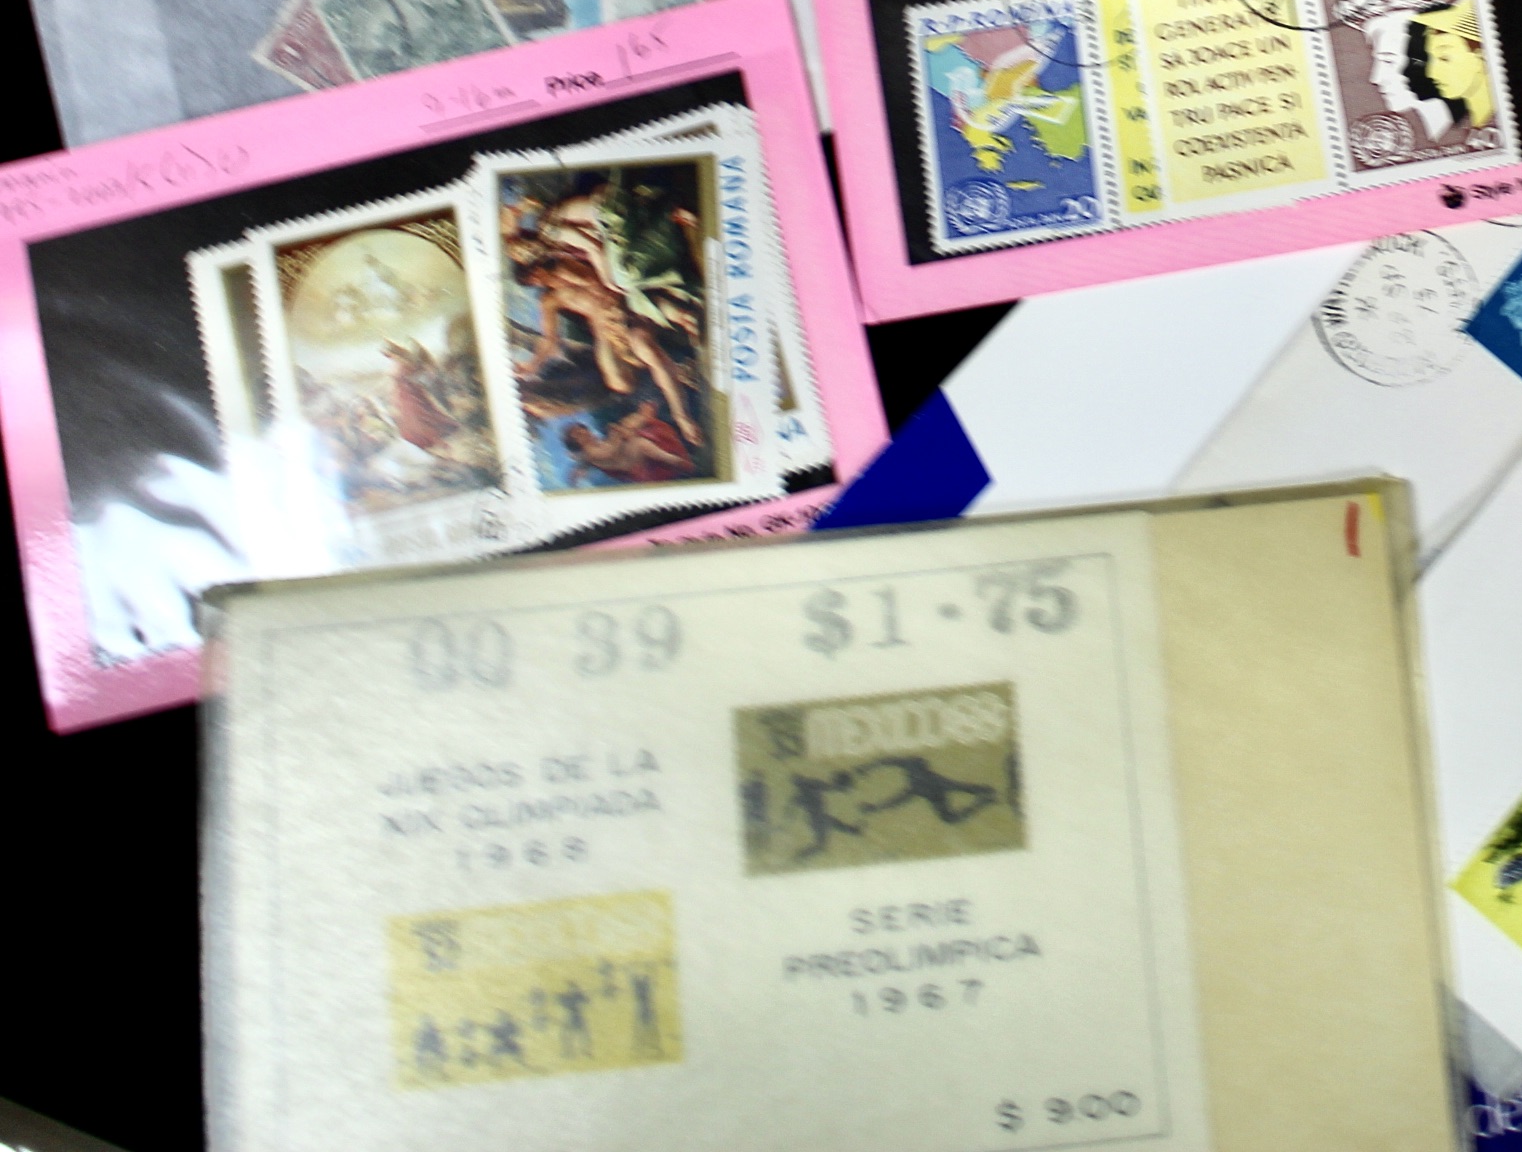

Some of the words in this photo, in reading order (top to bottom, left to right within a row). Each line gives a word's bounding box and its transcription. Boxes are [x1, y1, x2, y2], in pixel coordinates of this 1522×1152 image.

[540, 753, 593, 784] DE
[605, 747, 663, 778] LA
[848, 897, 973, 936] SERIE
[850, 977, 985, 1018] 1967
